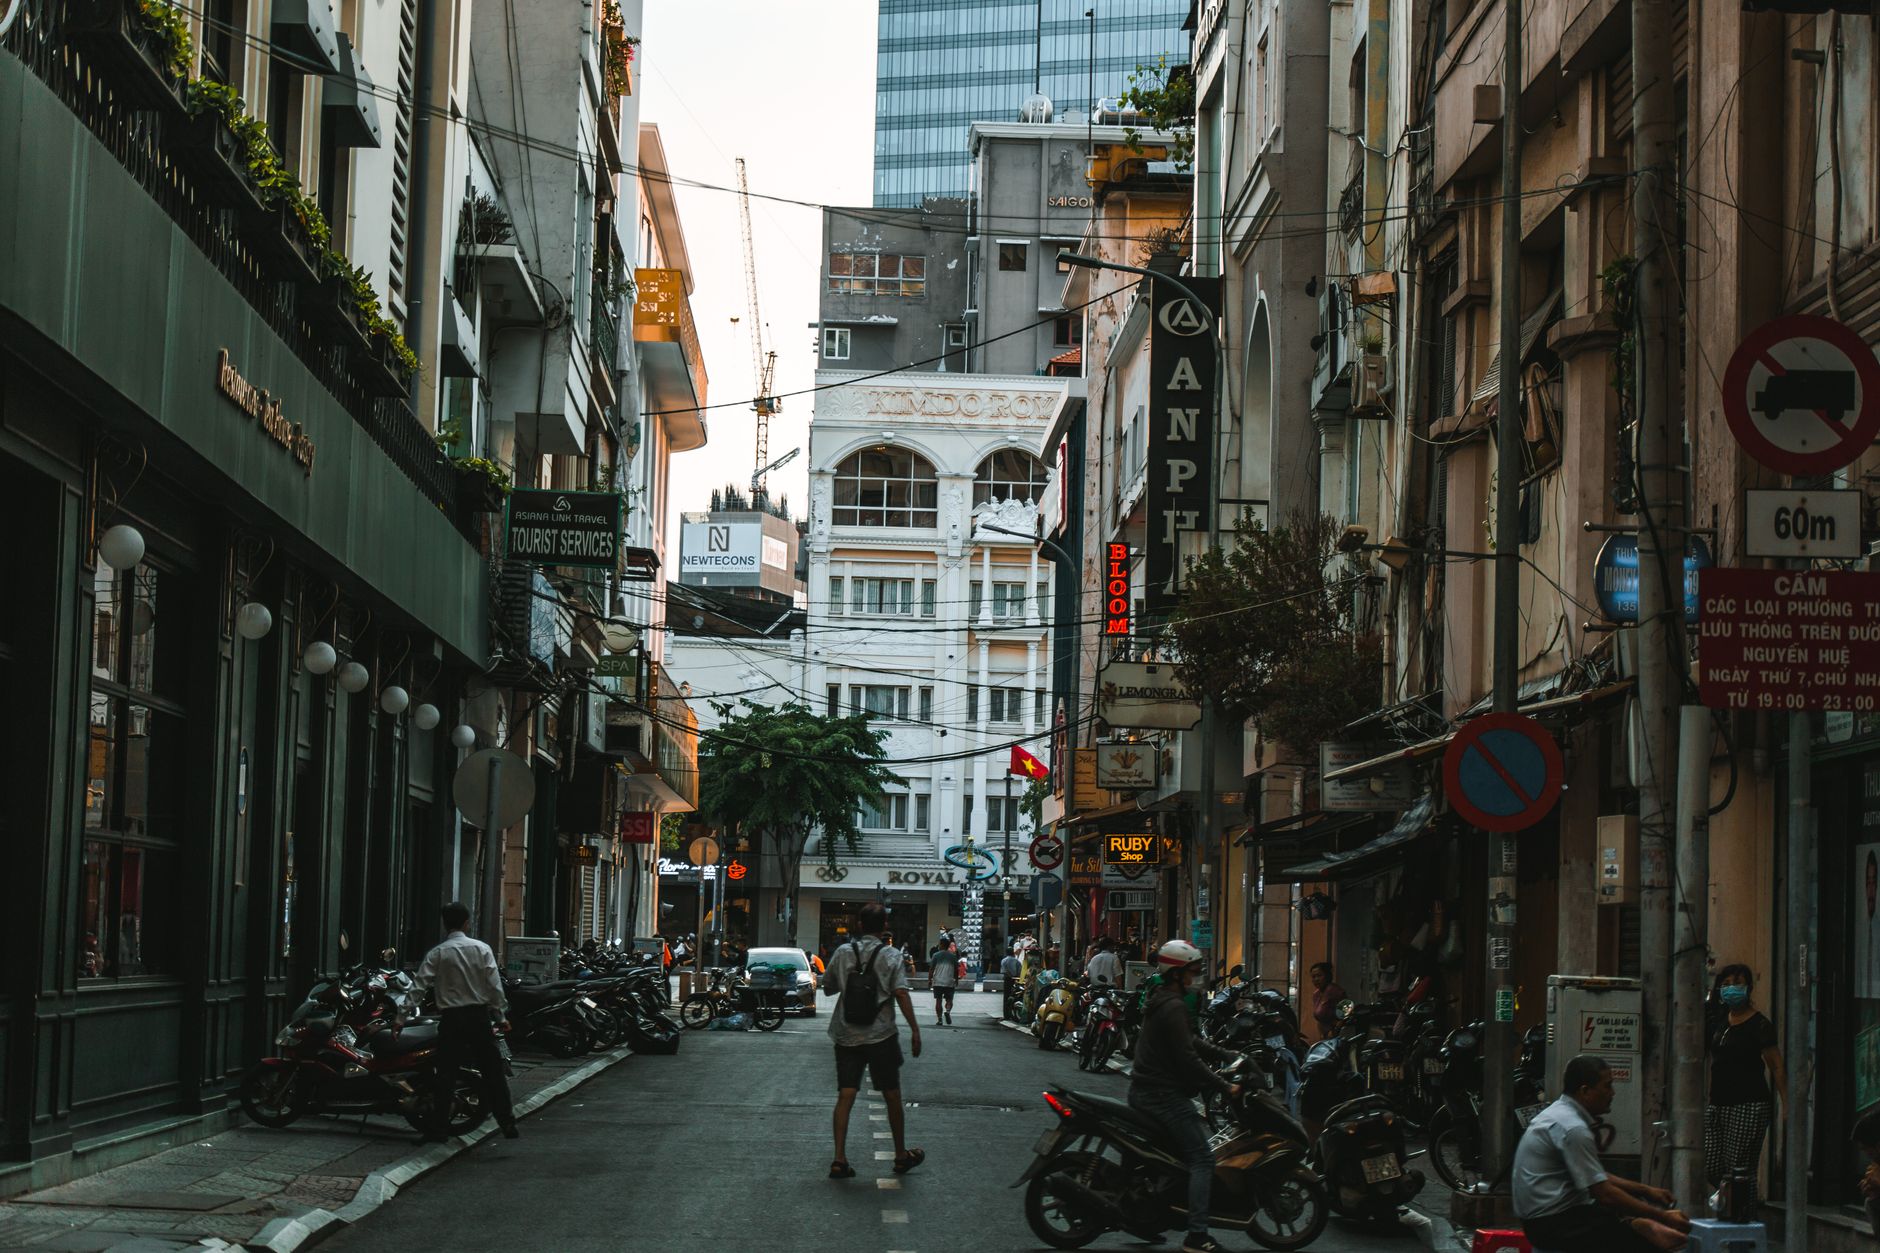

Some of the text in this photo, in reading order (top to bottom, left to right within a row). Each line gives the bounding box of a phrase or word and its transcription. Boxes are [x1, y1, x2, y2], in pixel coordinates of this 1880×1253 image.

[867, 391, 982, 417] KIMDO
[515, 511, 608, 525] ASIANA LINK TRAVEL
[1774, 507, 1835, 541] 60m
[512, 527, 614, 558] TOURIST SERVICES
[682, 556, 755, 566] NEWTECONS
[1107, 543, 1129, 635] BLOOM
[1774, 570, 1828, 596] CẤM
[1617, 601, 1637, 612] 135
[1706, 594, 1737, 615] CÁC
[1744, 600, 1780, 620] LOẠI
[1787, 599, 1853, 617] PHƯƠNG
[1701, 619, 1732, 637] LƯU
[1739, 621, 1793, 639] THÔNG
[1801, 622, 1841, 641] TRÊN
[1743, 641, 1850, 668] NGUYỄN HUỆ
[600, 660, 630, 672] SPA
[1708, 665, 1750, 683] NGÀY
[1759, 667, 1792, 685] THỨ
[1727, 688, 1749, 708] TỪ
[624, 818, 650, 836] SSI
[1110, 837, 1153, 852] RUBY
[1120, 852, 1144, 862] Shop
[888, 870, 960, 886] ROYAL
